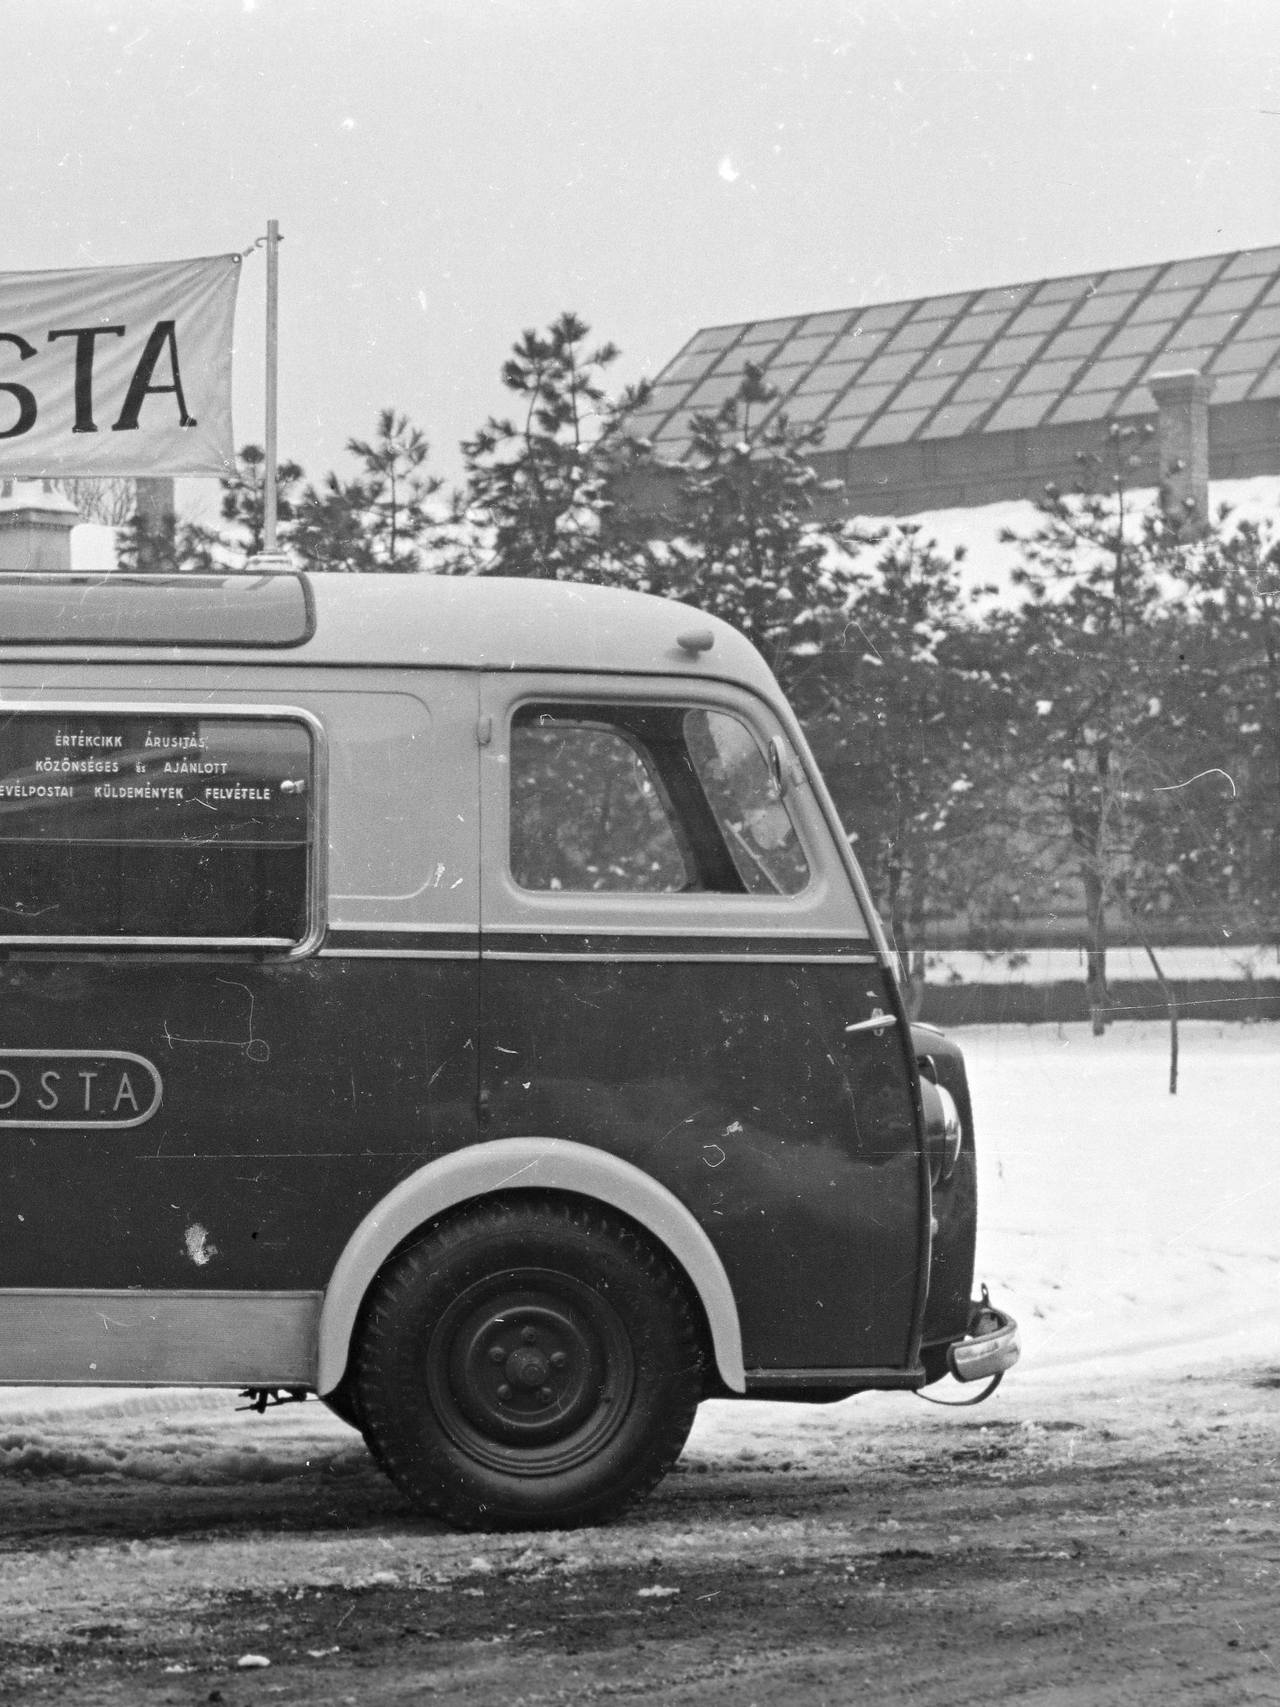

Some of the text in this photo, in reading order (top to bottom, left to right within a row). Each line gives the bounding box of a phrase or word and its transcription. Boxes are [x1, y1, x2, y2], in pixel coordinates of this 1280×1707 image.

[55, 729, 122, 747] ÉRTÉKCIKK
[164, 757, 227, 773] AJÁNLOTT
[94, 781, 183, 799] KÜLDEMÉNYEK
[205, 782, 270, 799] FELVÉTELE
